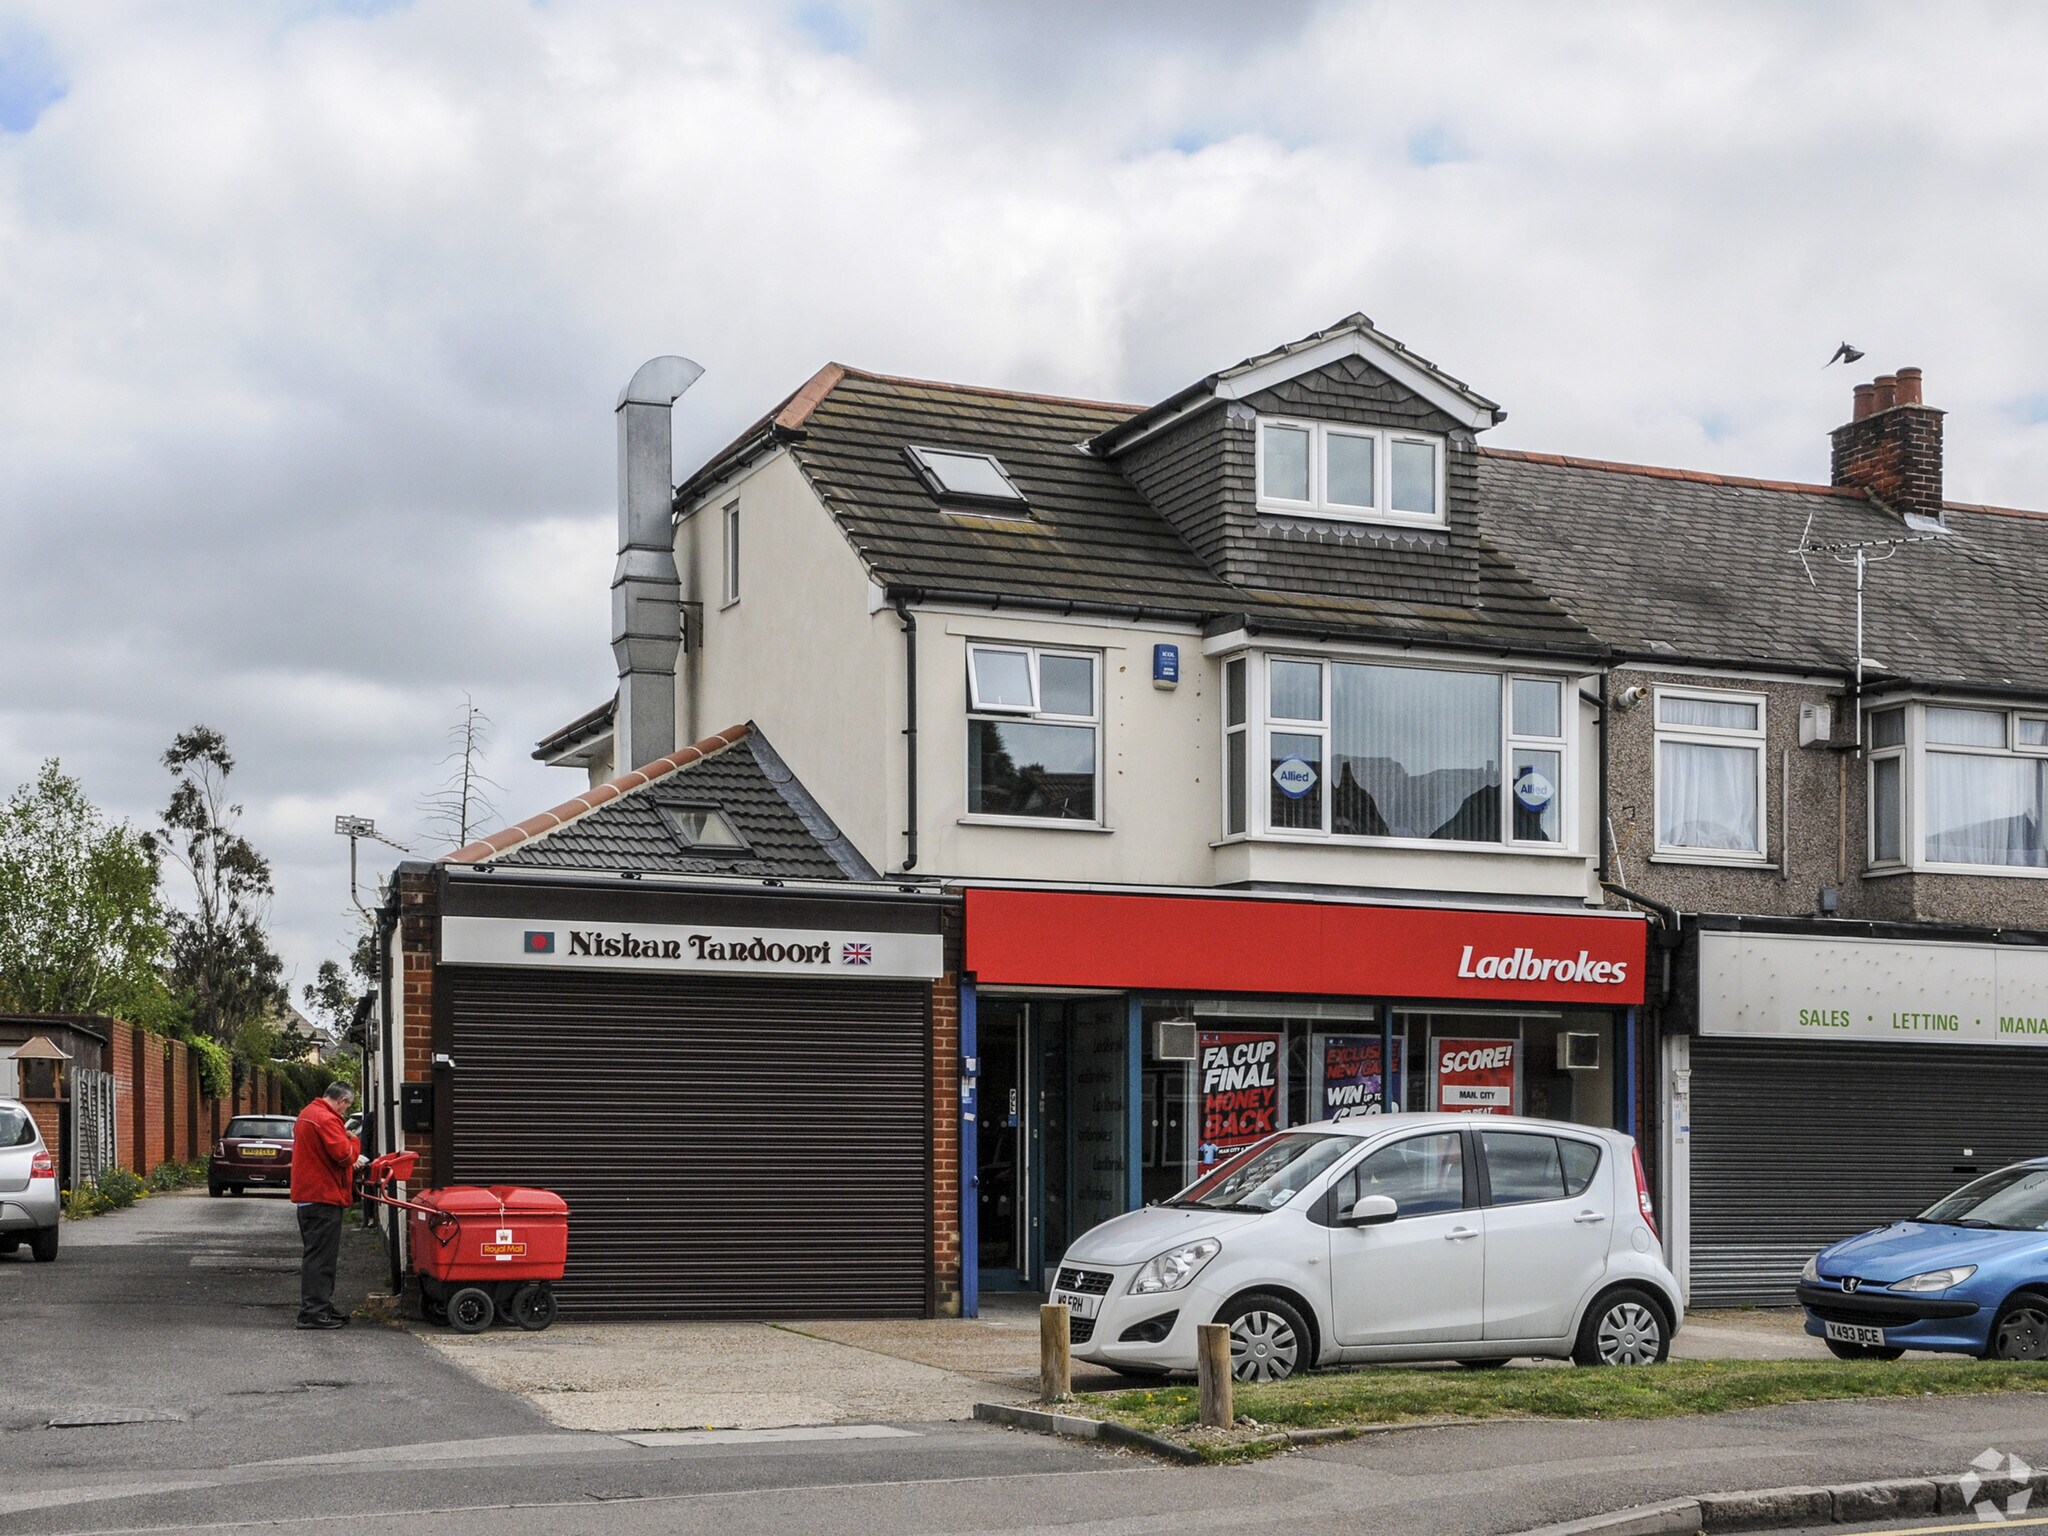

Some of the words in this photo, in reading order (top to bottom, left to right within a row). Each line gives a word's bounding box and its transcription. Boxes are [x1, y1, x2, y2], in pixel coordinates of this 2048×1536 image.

[1281, 770, 1309, 782] Allied
[1521, 784, 1548, 795] Allied
[568, 930, 681, 959] Nishan
[688, 934, 832, 964] Tandoori
[1457, 945, 1628, 984] Ladbrokes
[1799, 1008, 1850, 1028] SALES
[1893, 1012, 1959, 1031] LETTING
[2000, 1016, 2048, 1034] MANA
[1202, 1046, 1229, 1069] FA
[1232, 1041, 1276, 1066] CUP
[1440, 1045, 1513, 1074] SCORE!
[1203, 1063, 1275, 1093] FINAL
[1327, 1063, 1360, 1079] NEW
[1204, 1086, 1276, 1113] MONEY
[1327, 1084, 1364, 1106] WIN
[1363, 1094, 1373, 1102] UP
[1459, 1091, 1478, 1099] MAN.
[1203, 1106, 1276, 1139] BACK
[484, 1245, 506, 1254] Royal
[507, 1245, 524, 1253] Mail
[1829, 1323, 1856, 1340] Y493
[1857, 1327, 1880, 1343] BCE
